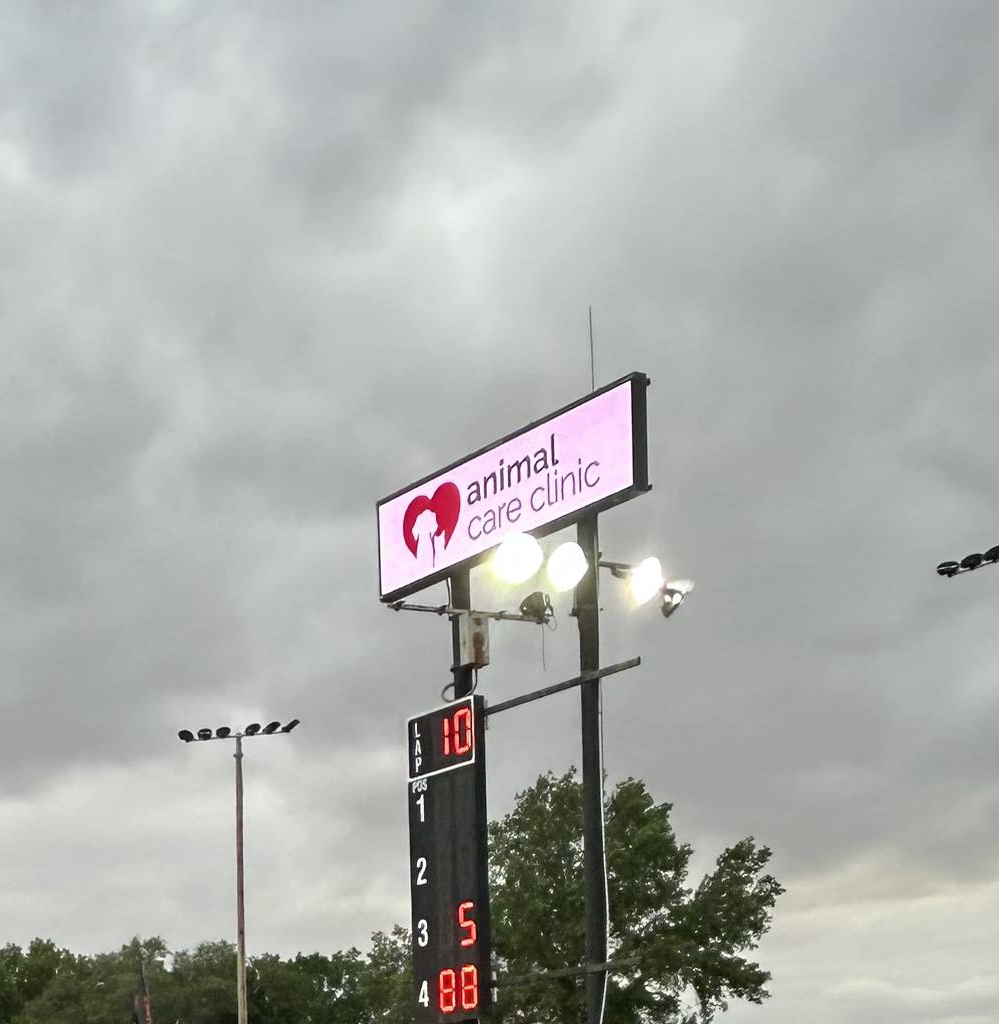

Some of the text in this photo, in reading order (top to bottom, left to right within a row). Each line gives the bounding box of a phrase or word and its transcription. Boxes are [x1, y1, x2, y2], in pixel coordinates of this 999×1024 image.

[467, 434, 558, 504] animal
[467, 458, 601, 540] care clinic
[414, 722, 423, 773] LAP
[442, 707, 472, 756] 10
[412, 779, 428, 792] POS
[417, 794, 425, 822] 1
[416, 857, 428, 886] 2
[417, 918, 429, 948] 3
[459, 902, 477, 947] 5
[418, 979, 430, 1008] 4
